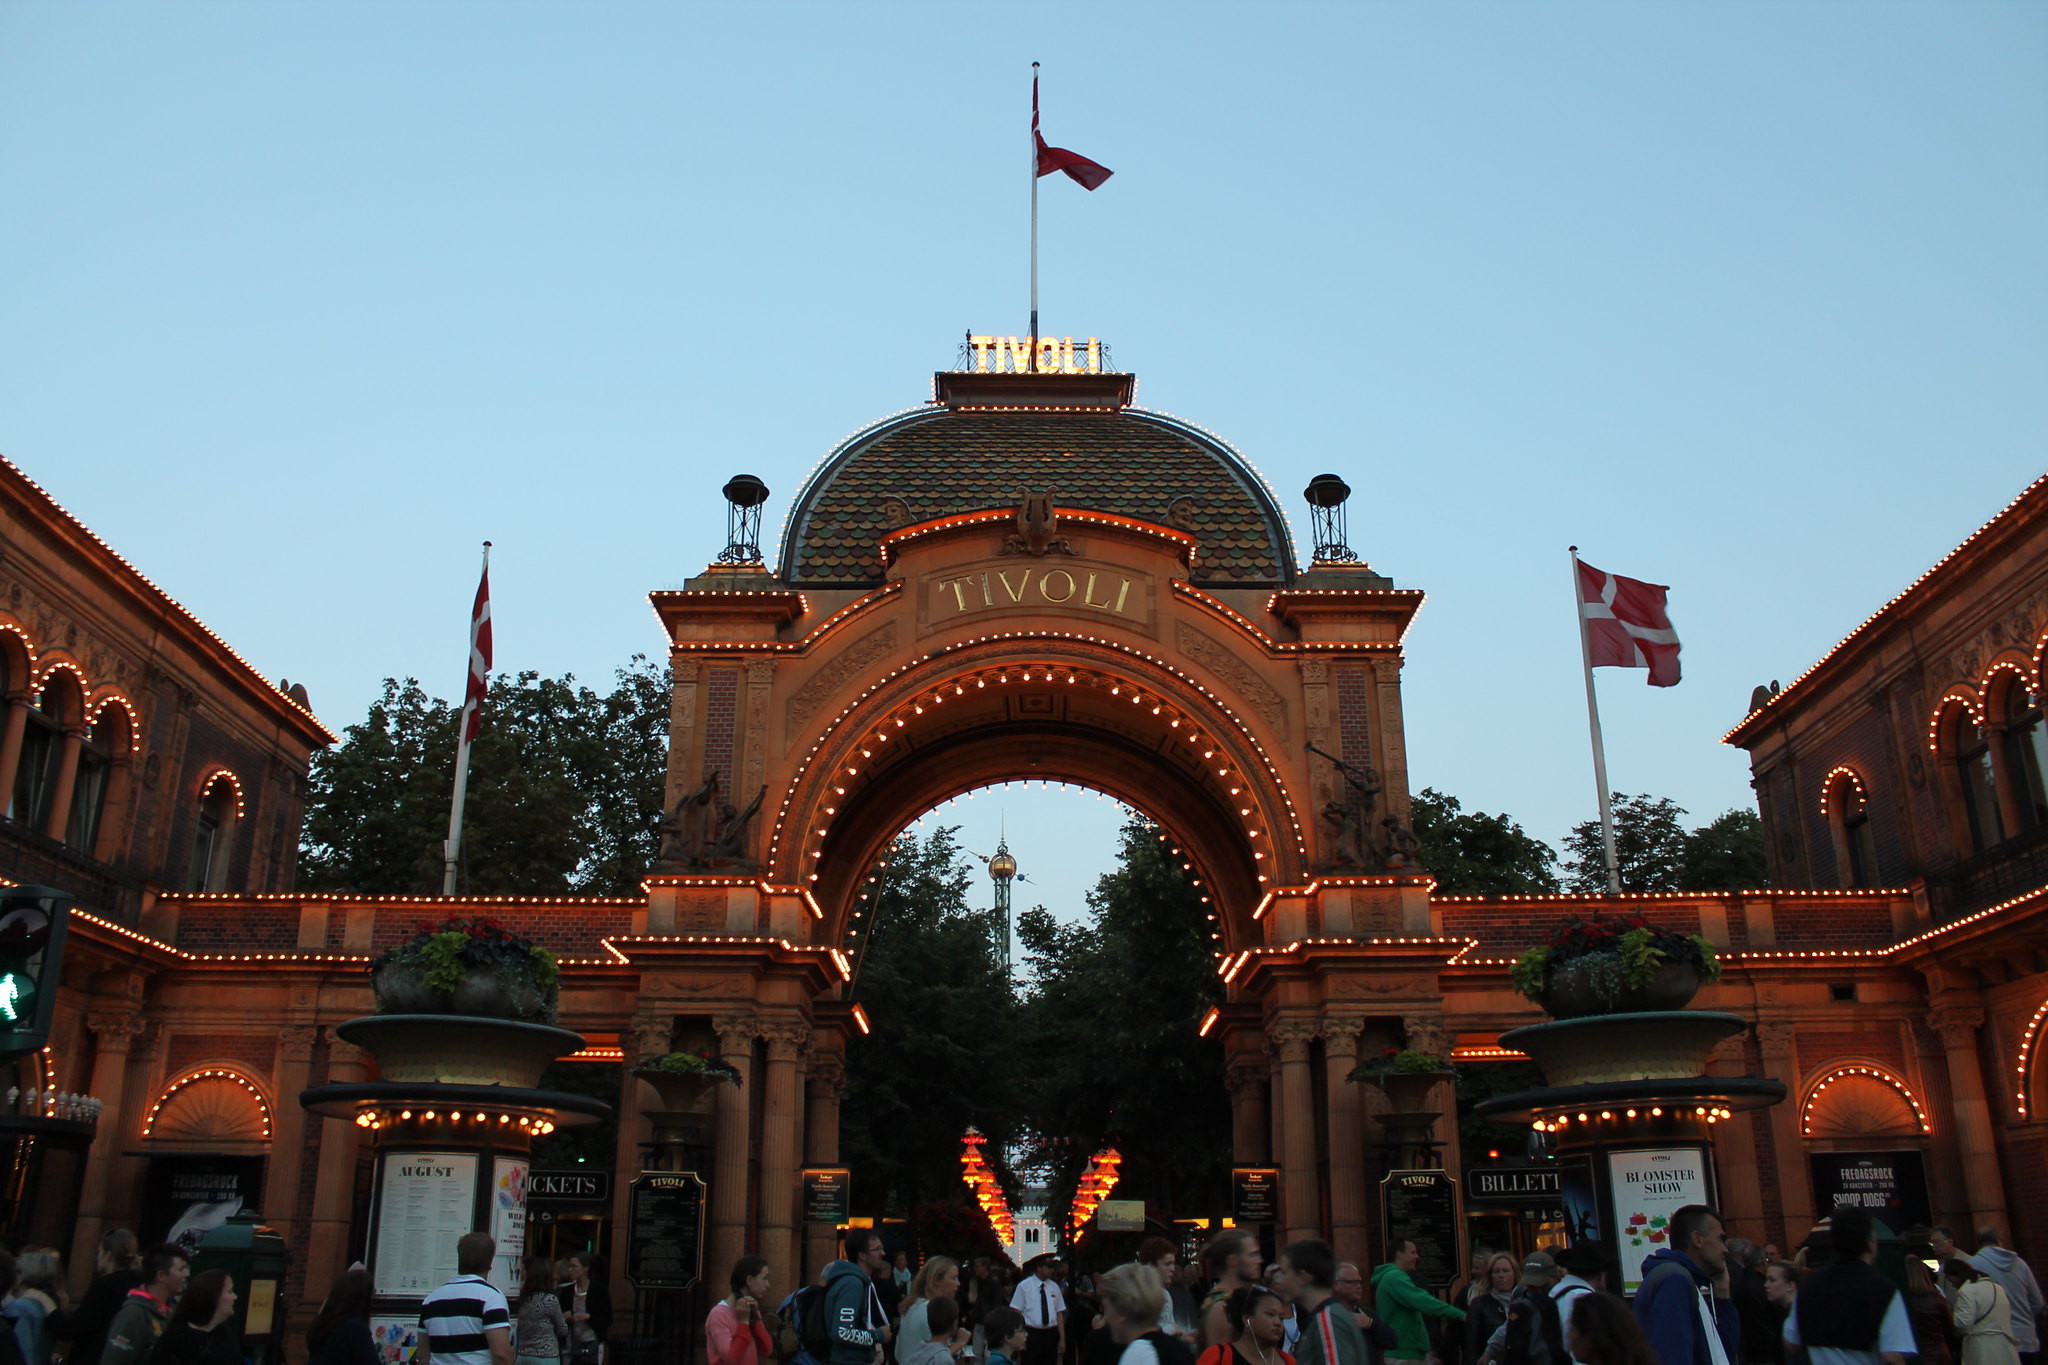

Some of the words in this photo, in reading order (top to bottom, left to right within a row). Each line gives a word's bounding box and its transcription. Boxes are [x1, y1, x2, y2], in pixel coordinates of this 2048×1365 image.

[970, 335, 1099, 374] TIVOLI
[938, 567, 1131, 612] TIVOLI
[398, 1166, 454, 1177] AUGUST
[1626, 1169, 1695, 1183] BLOMSTER
[1840, 1167, 1894, 1180] FREDAGSROCK
[173, 1174, 239, 1189] FREDAGSROCK
[527, 1175, 596, 1193] ICKETS
[650, 1177, 685, 1188] TIVOLI
[1401, 1175, 1436, 1186] TIVOLI
[1480, 1173, 1560, 1192] BILLETT
[1644, 1182, 1682, 1194] SHOW
[1833, 1192, 1861, 1208] SNOOP
[1863, 1192, 1886, 1207] DOGG
